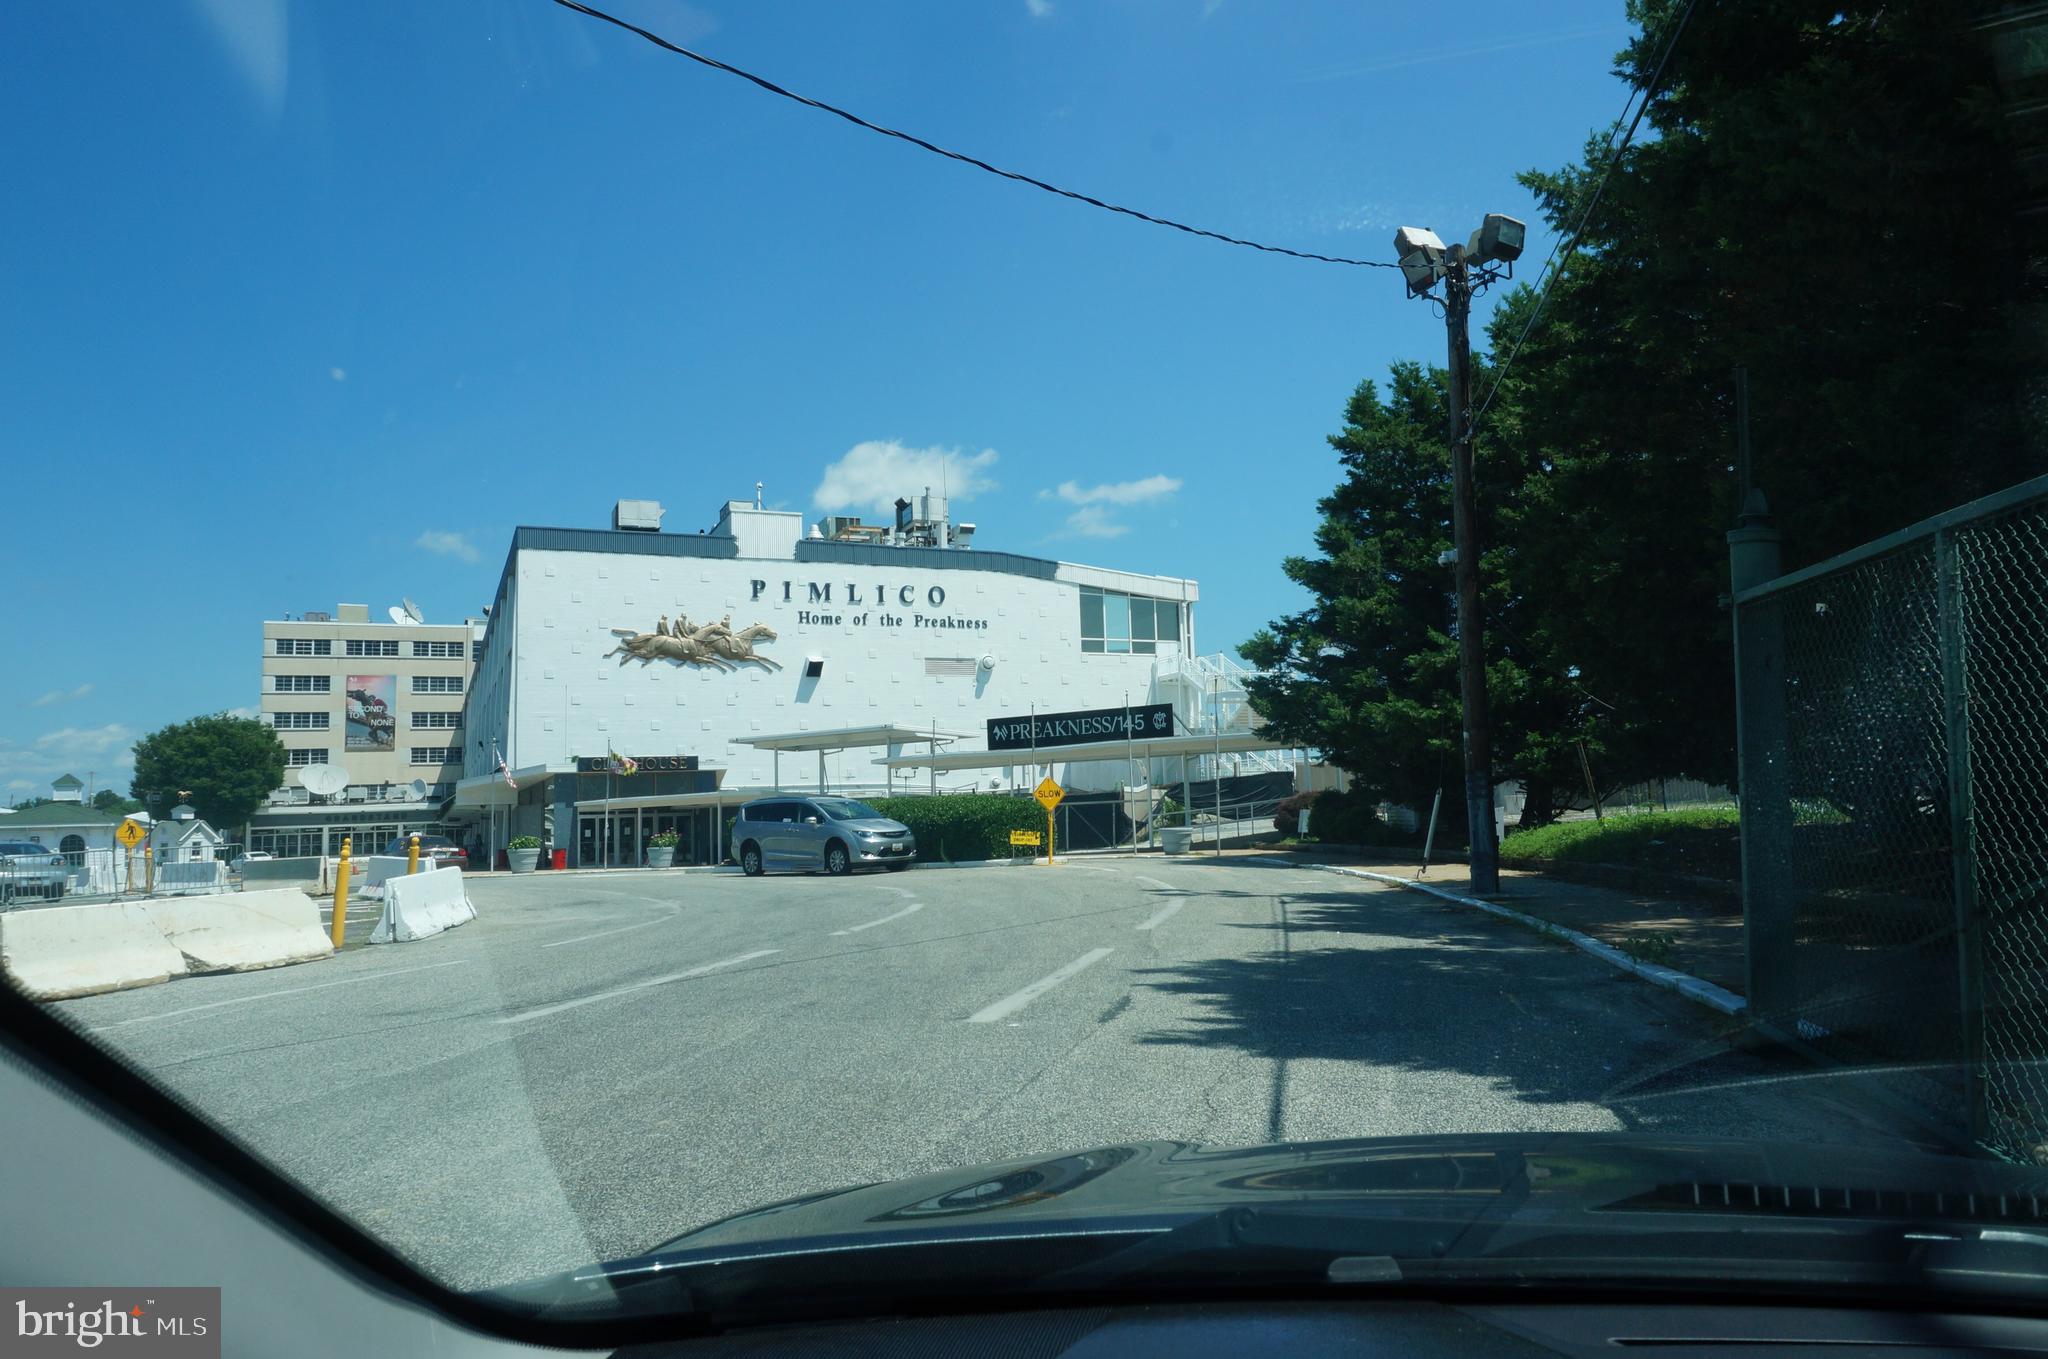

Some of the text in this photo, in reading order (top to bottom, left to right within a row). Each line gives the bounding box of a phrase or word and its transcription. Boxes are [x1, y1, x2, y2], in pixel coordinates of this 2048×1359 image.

[750, 579, 946, 608] PIMLICO
[798, 611, 988, 630] Home of the Preakness
[348, 705, 384, 713] SECOND
[591, 756, 688, 771] CLHOUSE
[1038, 789, 1061, 798] SLOW
